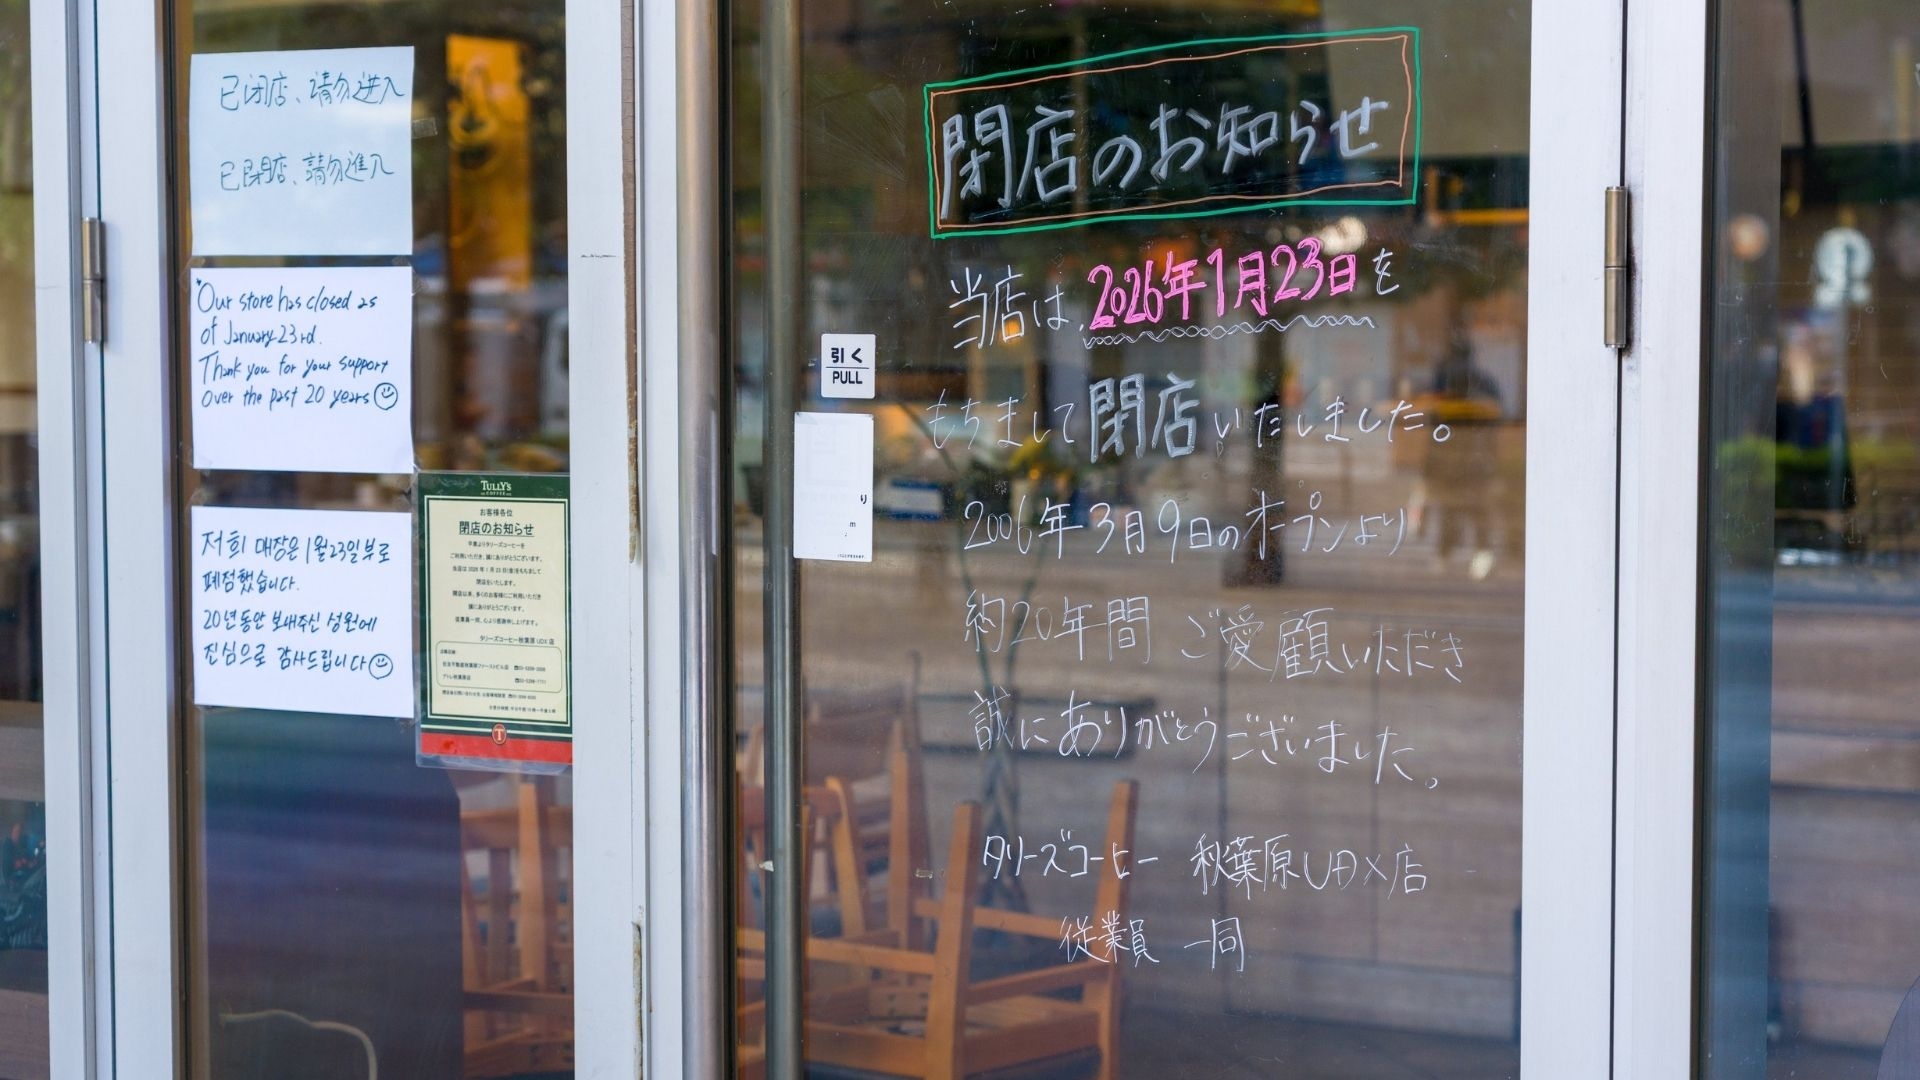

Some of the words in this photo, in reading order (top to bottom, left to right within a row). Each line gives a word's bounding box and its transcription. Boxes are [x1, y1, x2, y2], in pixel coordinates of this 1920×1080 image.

[940, 96, 1389, 220] 閉店のお知らせ
[197, 282, 233, 313] Our
[239, 291, 273, 309] store
[278, 285, 301, 312] has
[306, 286, 352, 312] closed
[357, 294, 378, 308] as
[200, 315, 217, 346] of
[223, 320, 277, 348] January
[198, 350, 242, 384] Thank
[246, 366, 270, 382] you
[278, 354, 297, 375] for
[302, 360, 332, 379] your
[339, 355, 389, 378] support
[832, 370, 862, 385] PULL
[243, 385, 262, 407] the
[269, 387, 298, 411] past
[304, 383, 325, 403] 20
[329, 390, 370, 409] years
[459, 521, 535, 536] 閉店のお知らせ
[480, 509, 513, 517] お客様各位
[963, 490, 1409, 564] 2006年3月9日のオープンより
[201, 530, 245, 559] 저희
[255, 536, 299, 561] 매장은
[203, 568, 300, 595] 폐점했습니다.
[203, 609, 266, 633] 20년동안
[272, 611, 321, 633] 보내주신
[327, 611, 377, 633] 성원에
[963, 588, 1152, 665] 約20年間
[1180, 603, 1464, 684] ご愛顧いただき
[203, 641, 266, 668] 진심으로
[277, 646, 366, 673] 감사드립니다
[969, 686, 1439, 790] 誠にありがとうございました。
[982, 829, 1159, 880] タリーズコーヒー
[1058, 910, 1160, 968] 従業員
[1183, 915, 1246, 973] 一同
